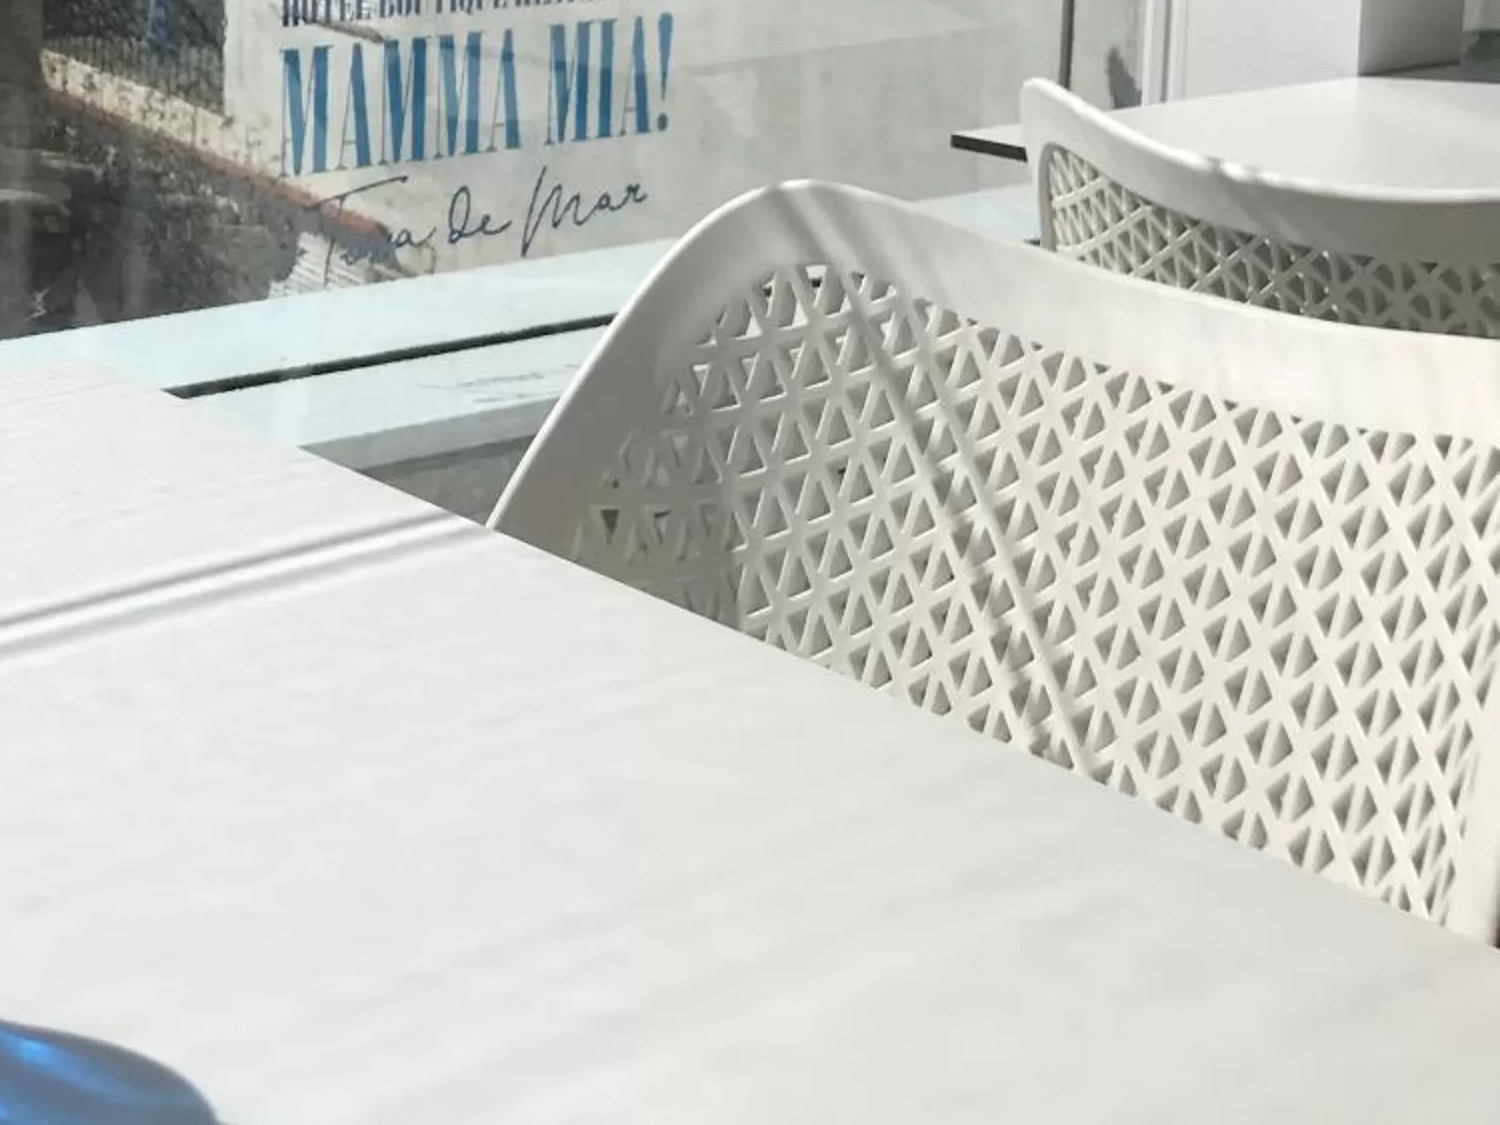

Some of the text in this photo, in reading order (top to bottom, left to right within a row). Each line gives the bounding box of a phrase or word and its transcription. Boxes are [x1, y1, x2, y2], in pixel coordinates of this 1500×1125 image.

[279, 12, 673, 177] MAMMA MIA!
[521, 165, 648, 257] Mar
